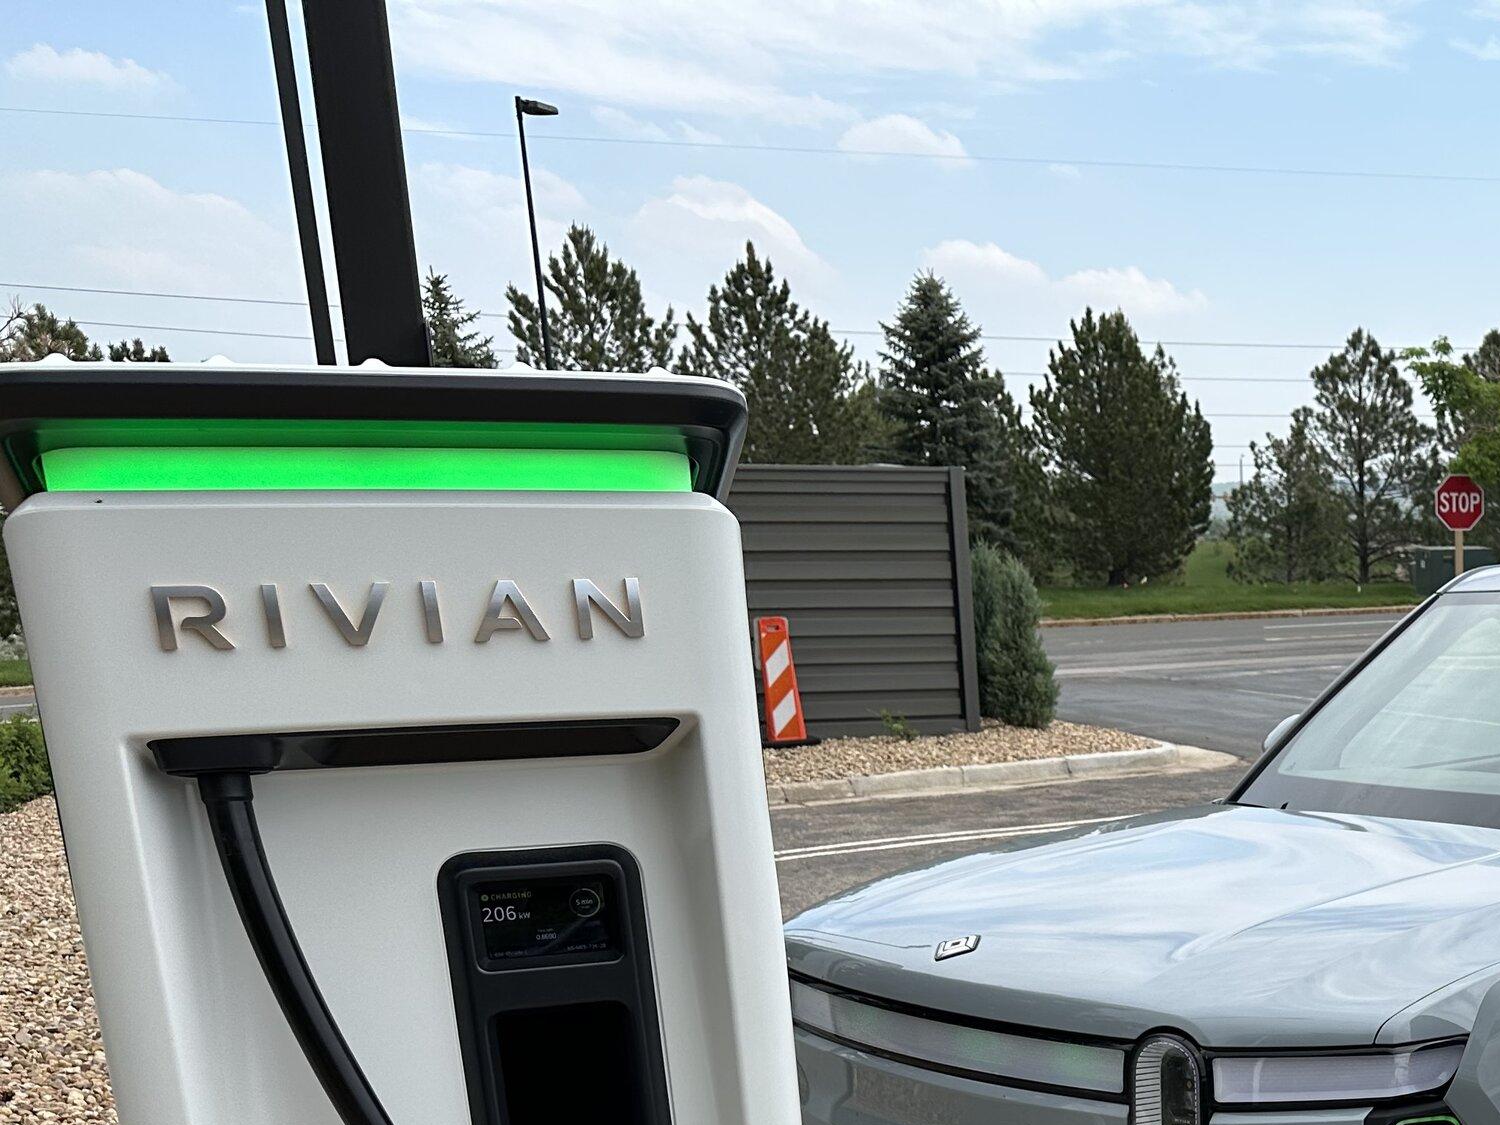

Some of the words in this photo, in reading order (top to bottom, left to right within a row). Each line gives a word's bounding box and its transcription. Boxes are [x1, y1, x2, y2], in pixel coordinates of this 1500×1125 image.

[1439, 492, 1481, 513] STOP
[150, 576, 645, 652] RIVIAN
[481, 905, 517, 923] 206
[518, 911, 531, 920] kW
